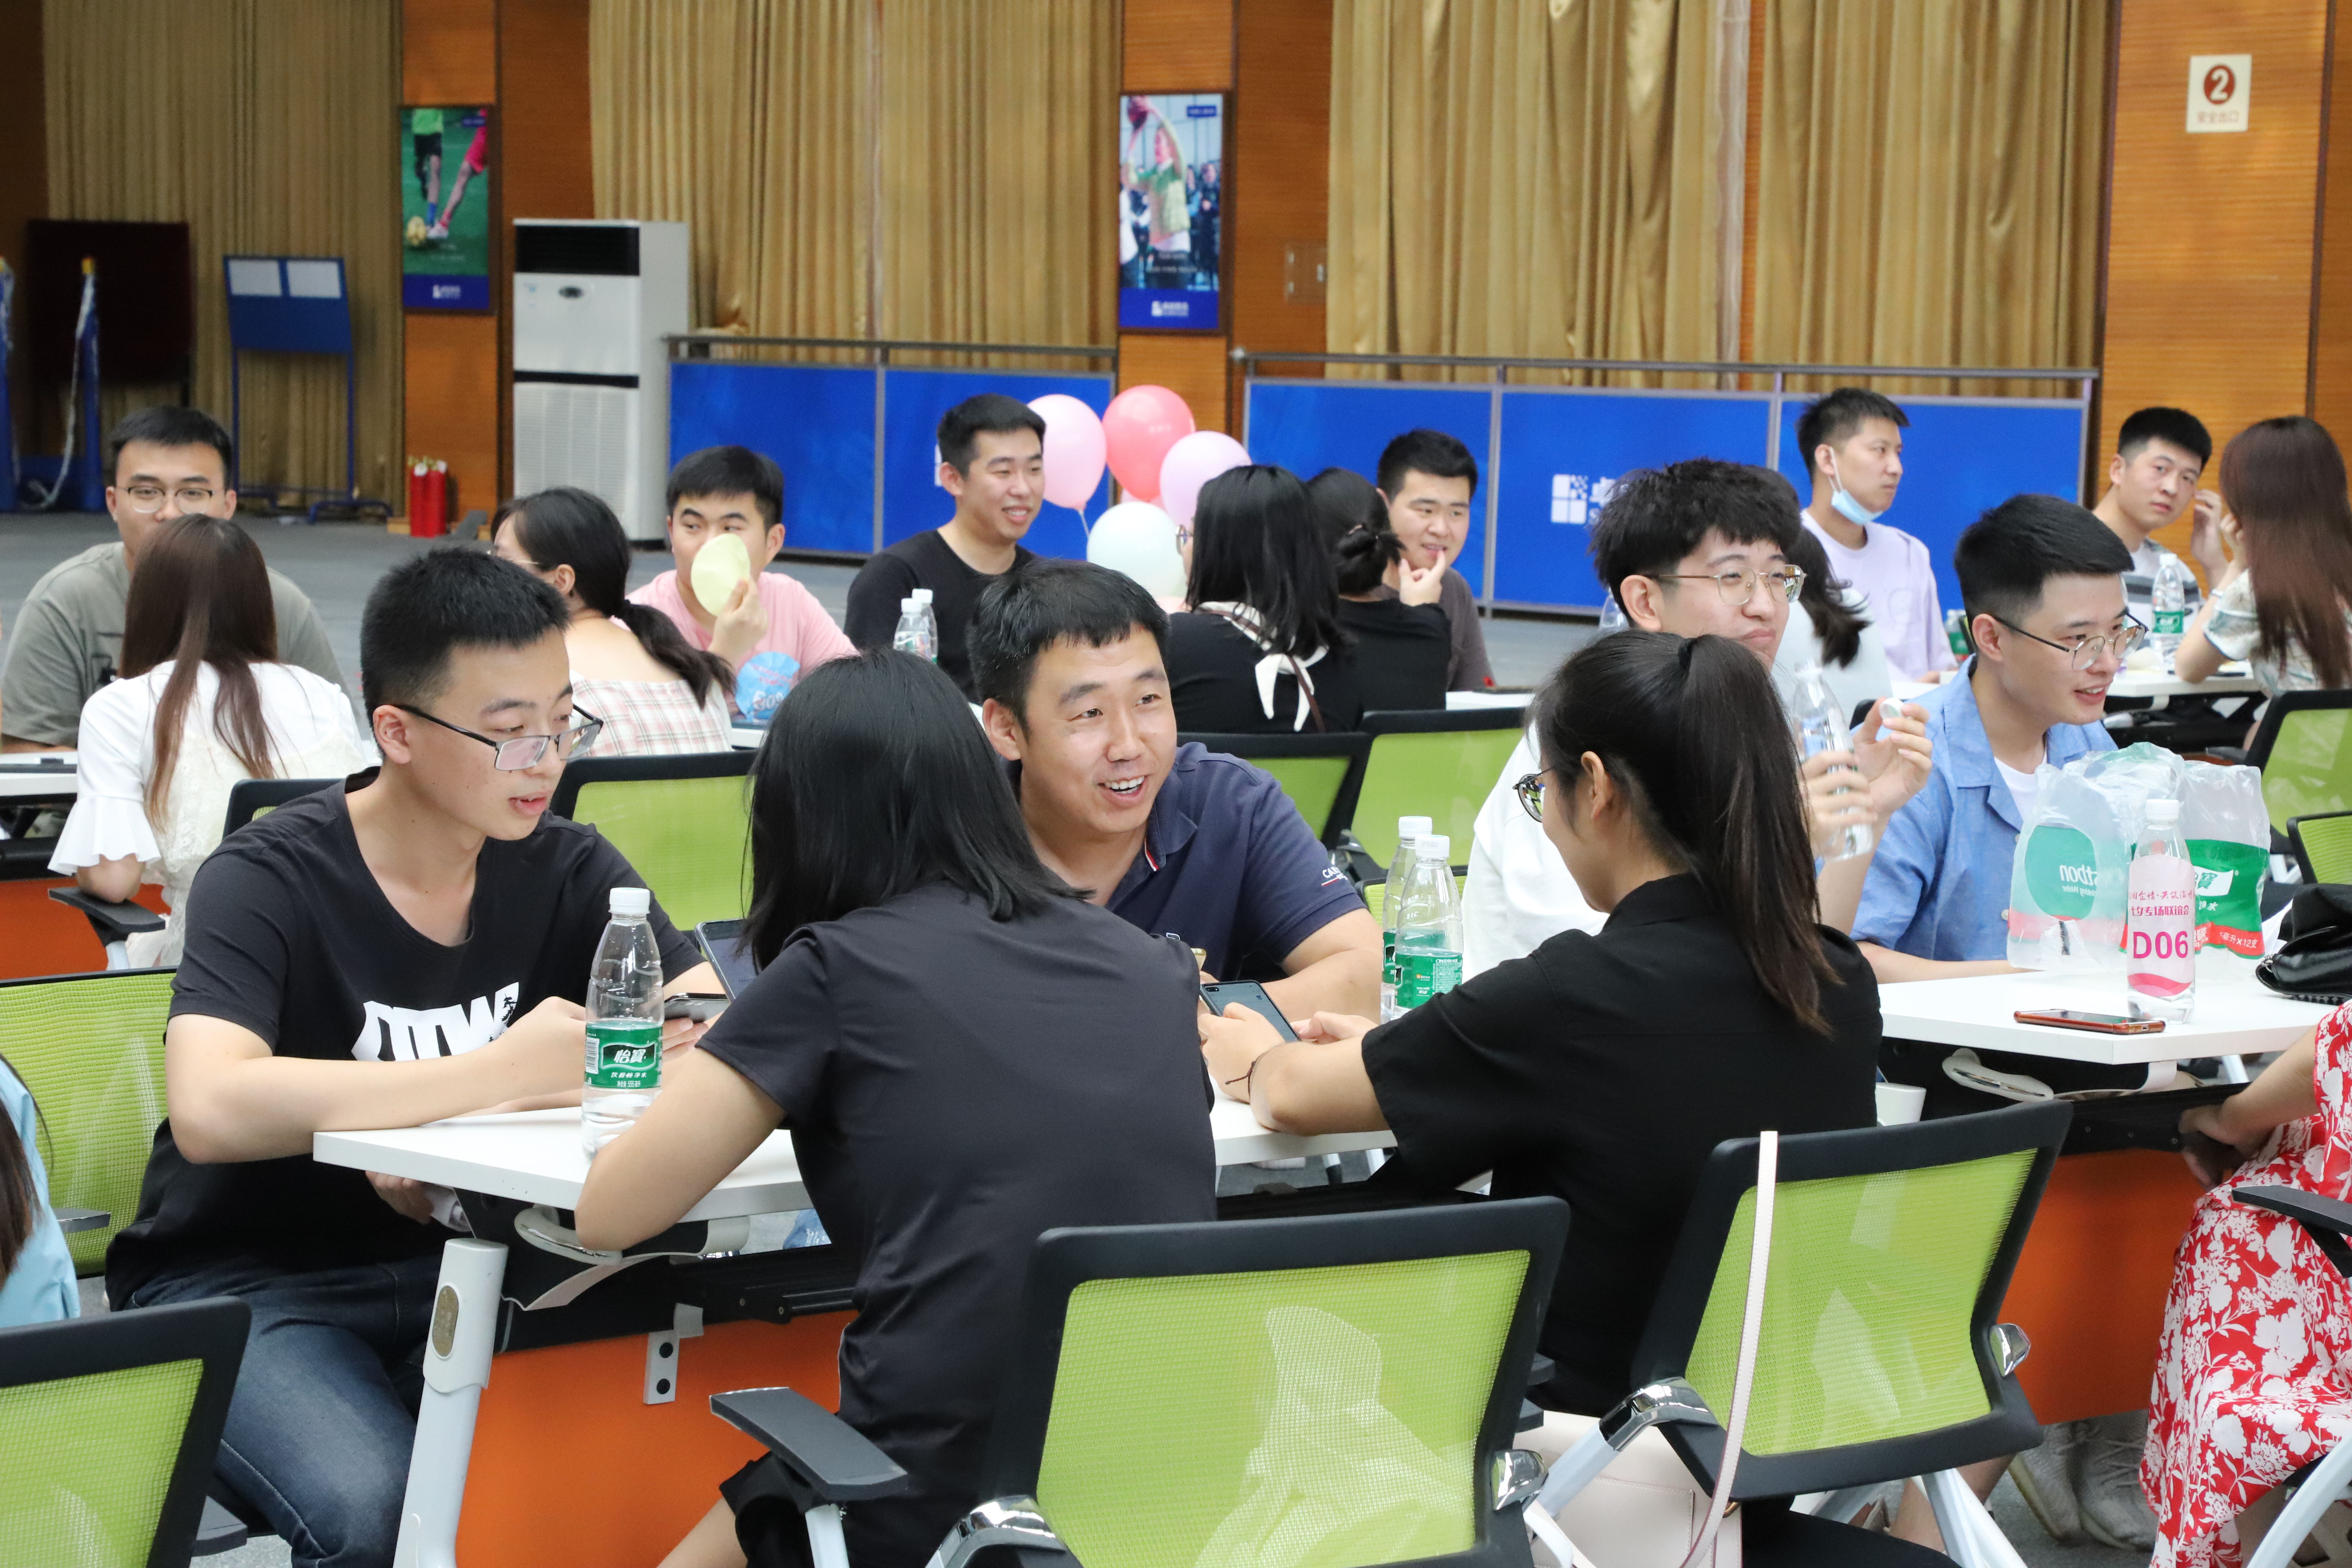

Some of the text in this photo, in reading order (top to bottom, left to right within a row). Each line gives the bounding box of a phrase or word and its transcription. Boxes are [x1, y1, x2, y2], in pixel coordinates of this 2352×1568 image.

[2210, 68, 2229, 101] 2
[2131, 905, 2189, 916] 七夕专场联谊会
[2133, 931, 2188, 959] D06
